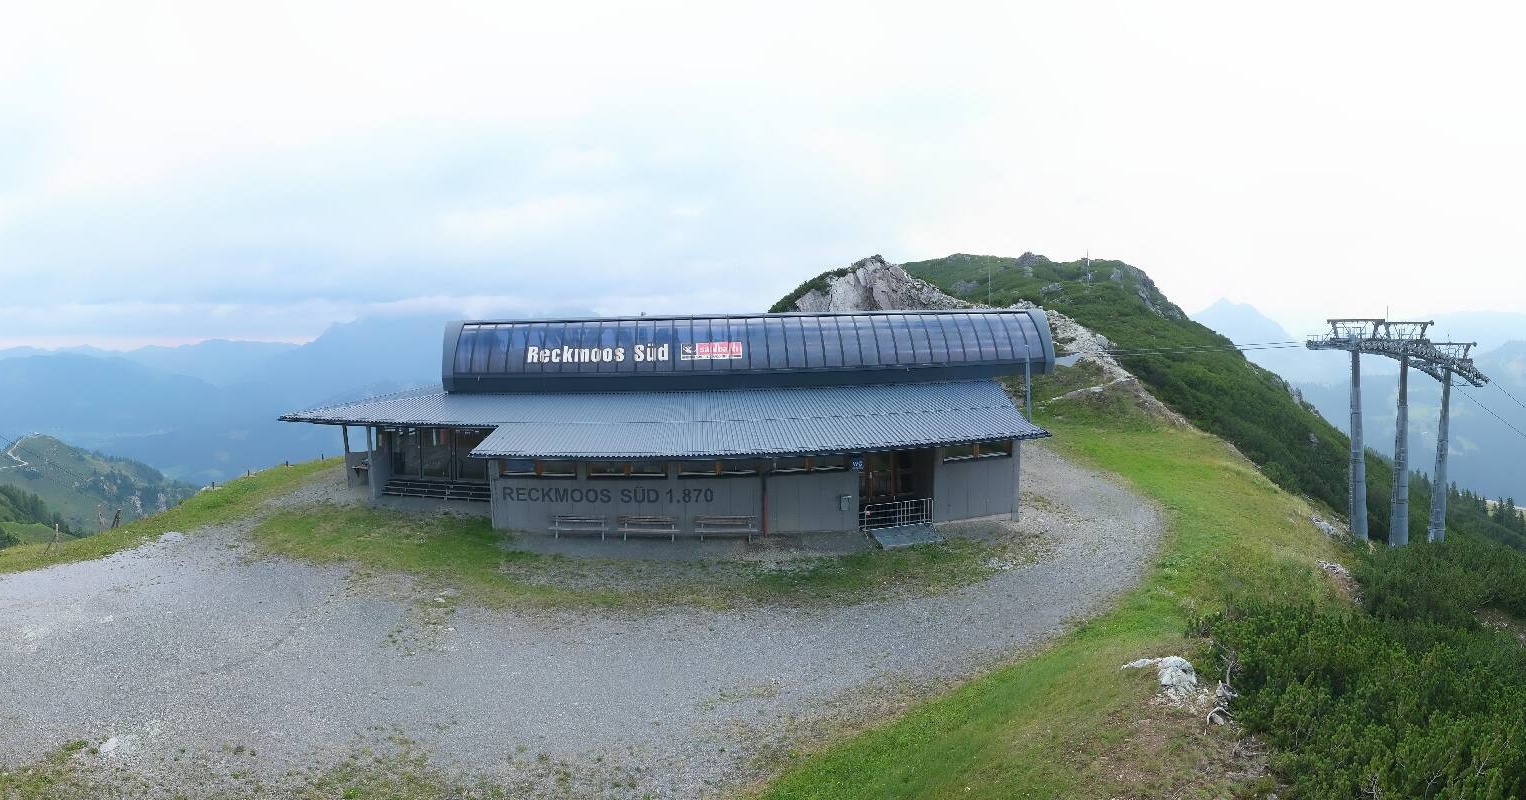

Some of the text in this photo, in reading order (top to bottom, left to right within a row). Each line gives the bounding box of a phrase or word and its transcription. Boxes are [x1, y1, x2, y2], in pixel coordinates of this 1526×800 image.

[527, 343, 669, 363] Reckmoos Süd
[502, 486, 714, 504] RECKMOOS SÜD 1.870
